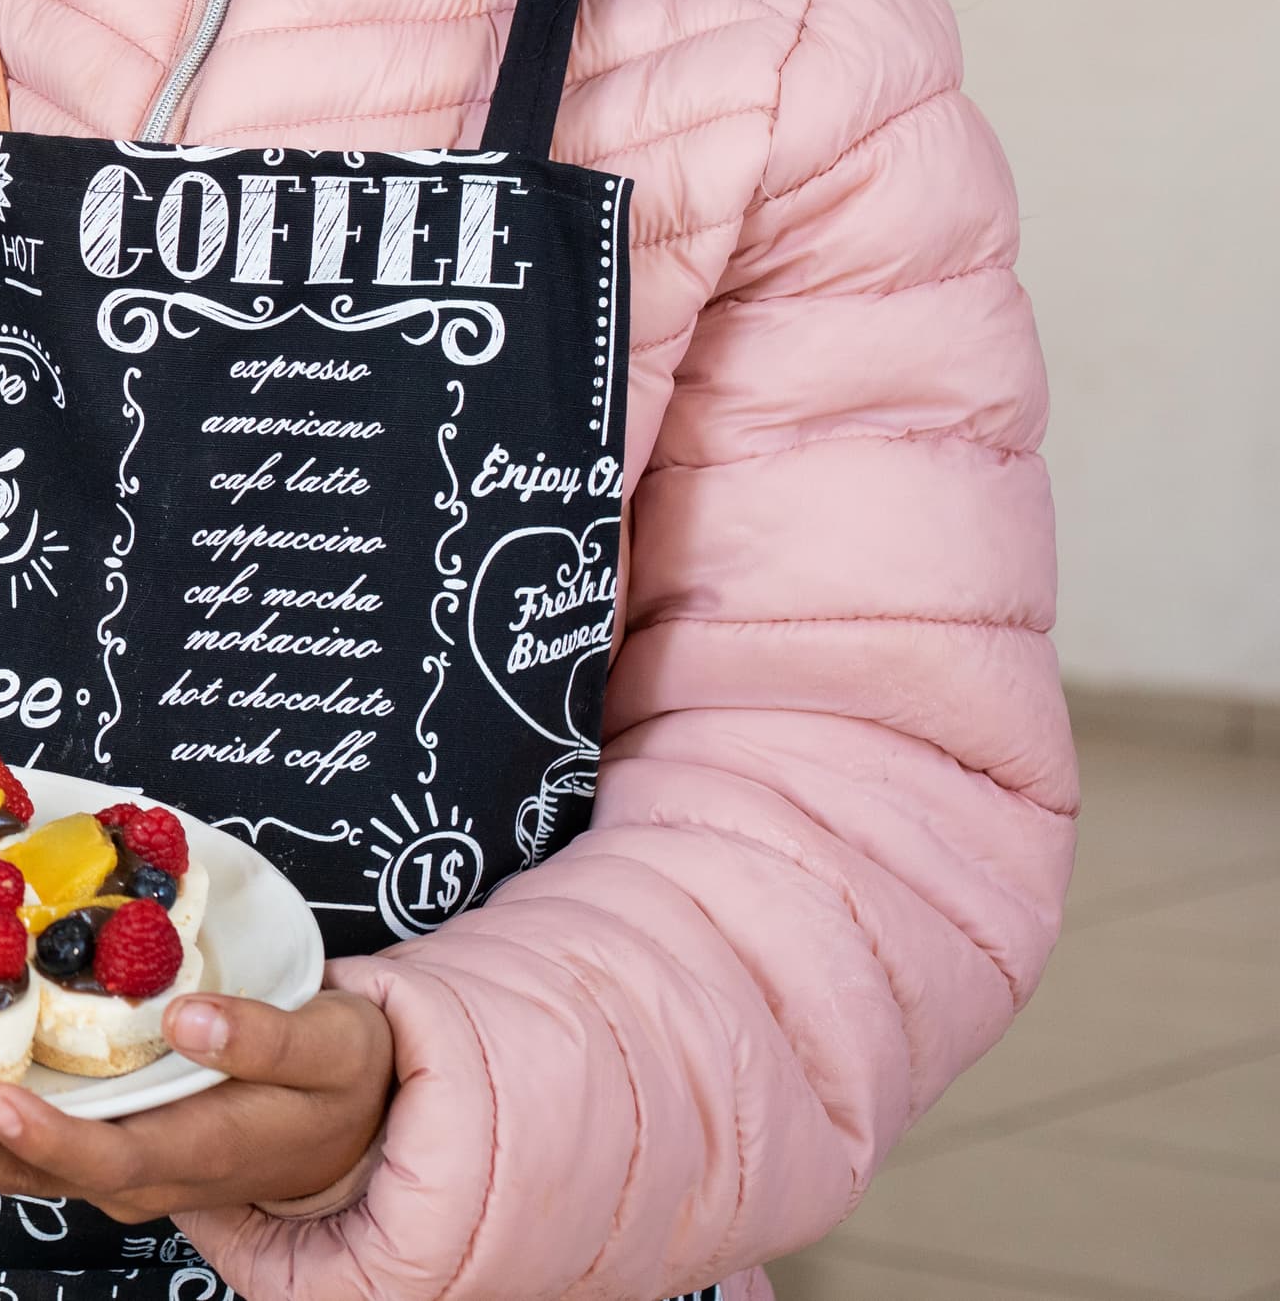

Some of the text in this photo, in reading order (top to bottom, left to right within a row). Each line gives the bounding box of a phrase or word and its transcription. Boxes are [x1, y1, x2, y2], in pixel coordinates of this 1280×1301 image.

[1, 233, 44, 275] HOT
[79, 164, 533, 289] COFFEE
[230, 354, 372, 394] expresso
[200, 410, 386, 440] americano
[209, 451, 371, 506] cafe latte
[470, 442, 583, 505] Enjoy
[191, 523, 387, 562] cappuccino
[183, 562, 384, 620] cafe mocha
[183, 611, 383, 659] mokacino
[506, 609, 615, 675] Brewed
[157, 668, 396, 717] hot chocolate
[283, 729, 377, 786] coffe
[408, 849, 465, 914] 1$
